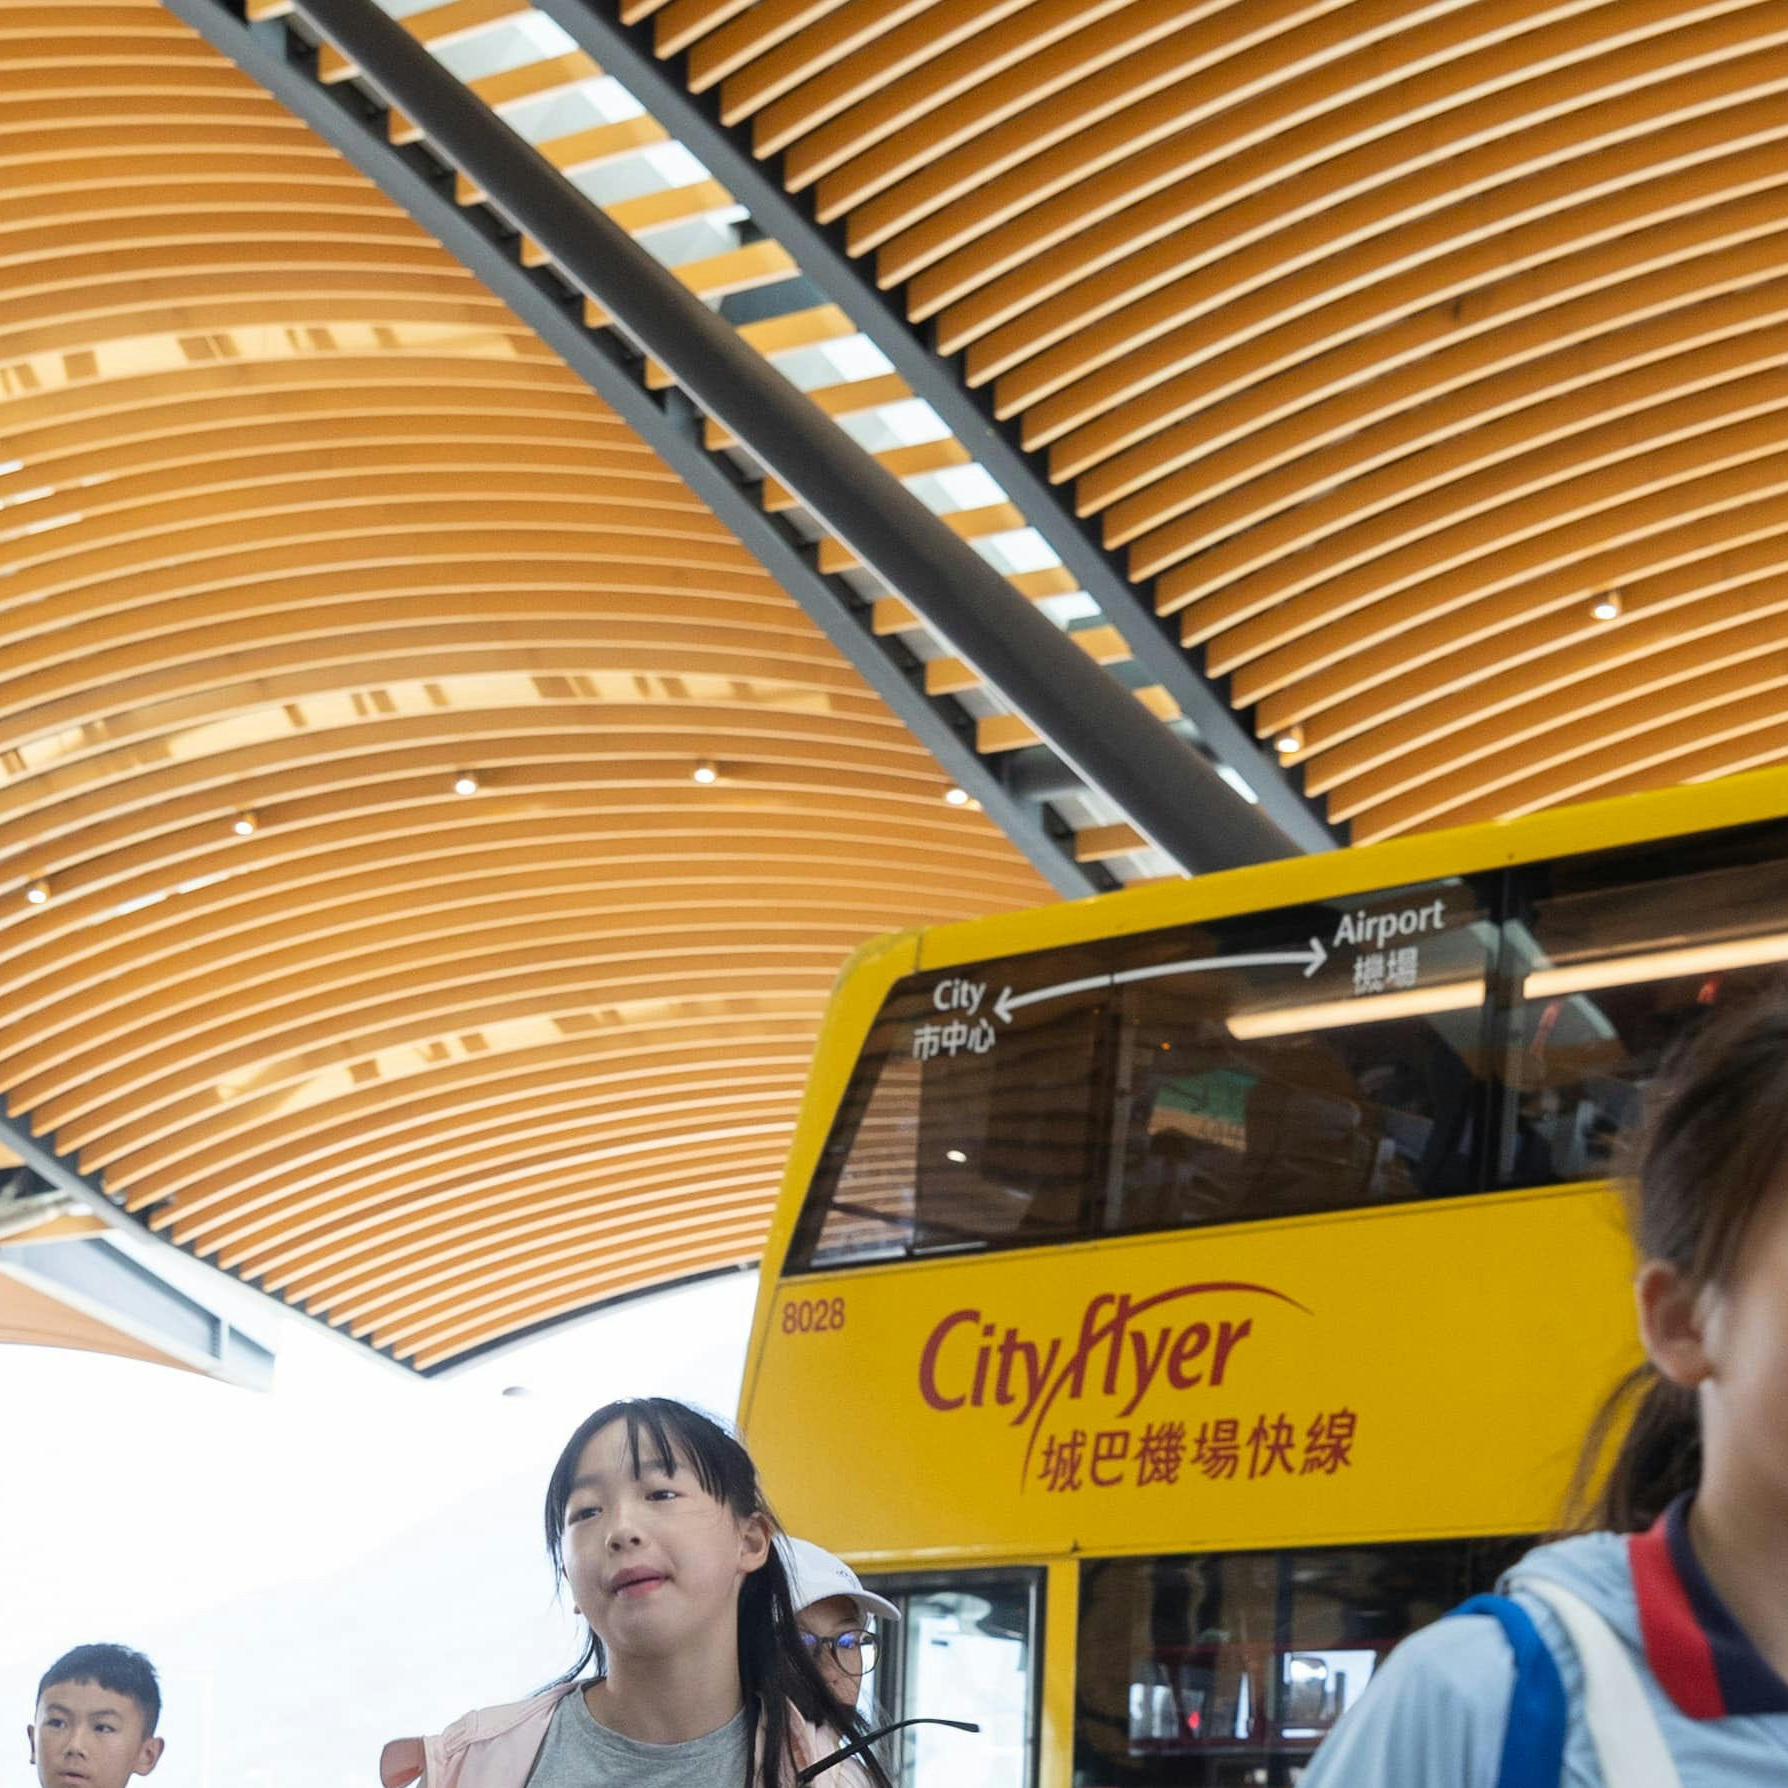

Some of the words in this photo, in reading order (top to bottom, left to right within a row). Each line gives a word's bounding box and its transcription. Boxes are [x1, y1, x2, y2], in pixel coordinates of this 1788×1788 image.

[1332, 899, 1445, 949] Airport
[1353, 946, 1418, 995] 機場
[933, 978, 987, 1016] City
[913, 1017, 996, 1061] 市中心
[782, 1296, 846, 1335] 8028
[918, 1292, 1253, 1428] Cityflyer
[1037, 1406, 1358, 1494] 城巴機場快線
